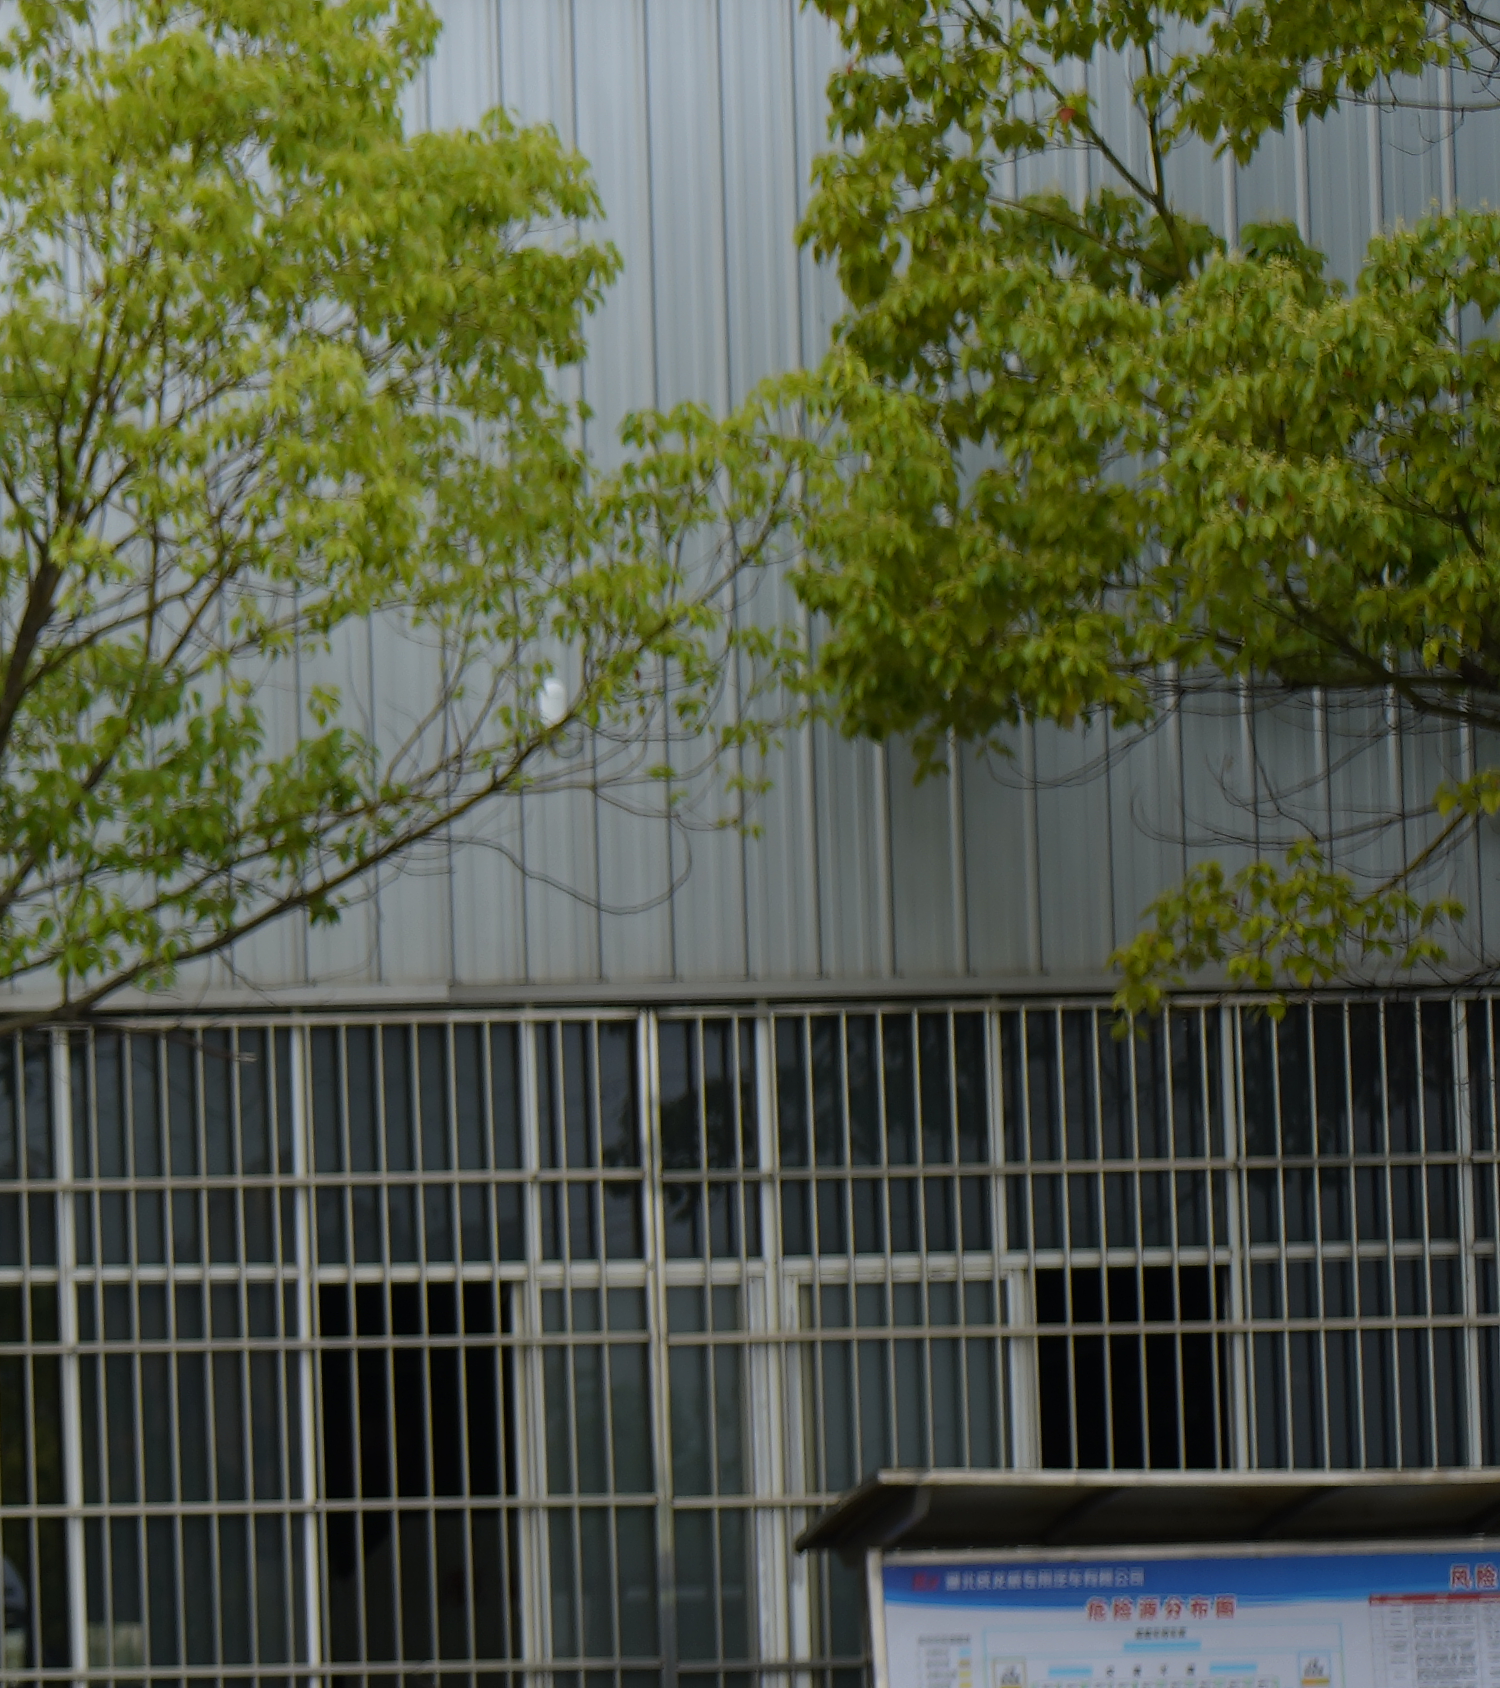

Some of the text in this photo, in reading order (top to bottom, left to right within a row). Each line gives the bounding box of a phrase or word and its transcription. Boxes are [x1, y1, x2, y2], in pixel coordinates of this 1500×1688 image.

[1086, 1595, 1237, 1621] 危险源分布图
